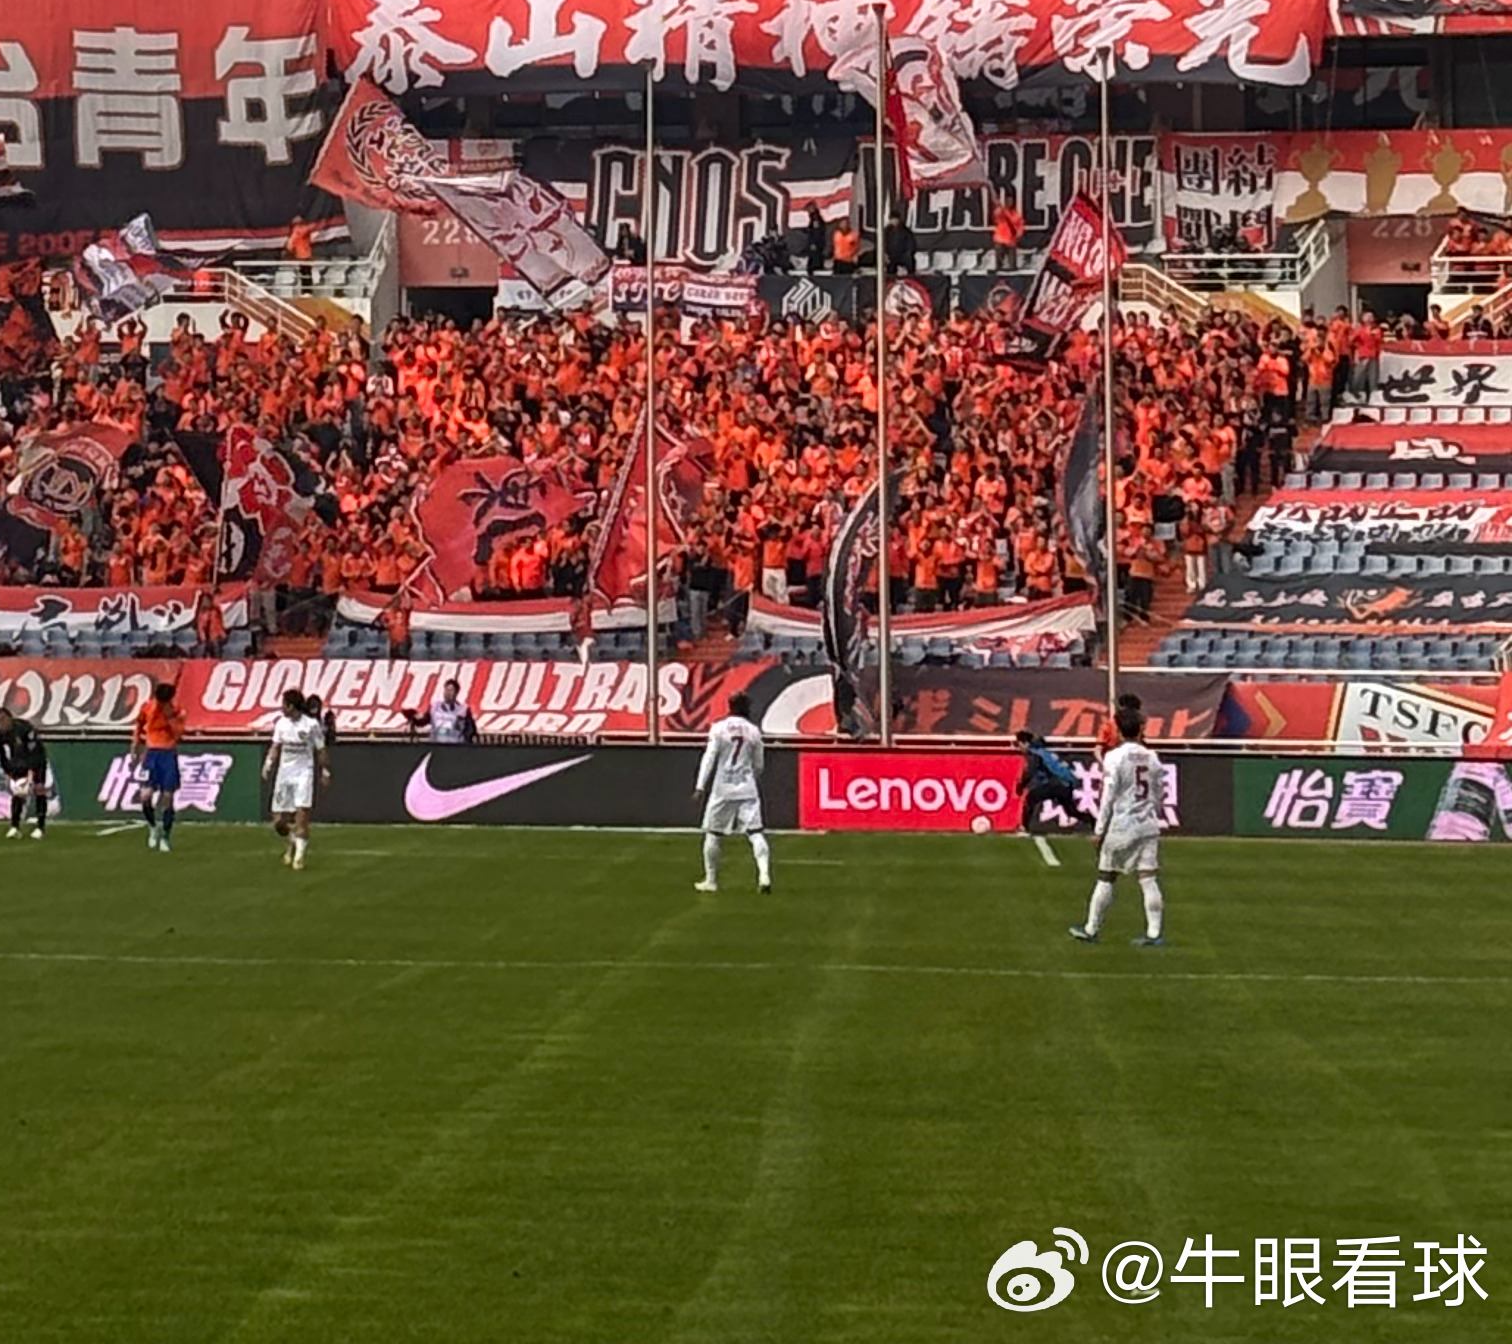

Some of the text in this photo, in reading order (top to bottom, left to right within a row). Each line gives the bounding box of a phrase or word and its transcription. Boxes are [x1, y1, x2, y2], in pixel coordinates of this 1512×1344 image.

[1377, 363, 1510, 405] 世界
[481, 658, 690, 716] ULTRAS
[730, 735, 744, 766] 7
[819, 768, 1008, 812] Lenovo
[1135, 764, 1150, 801] 5
